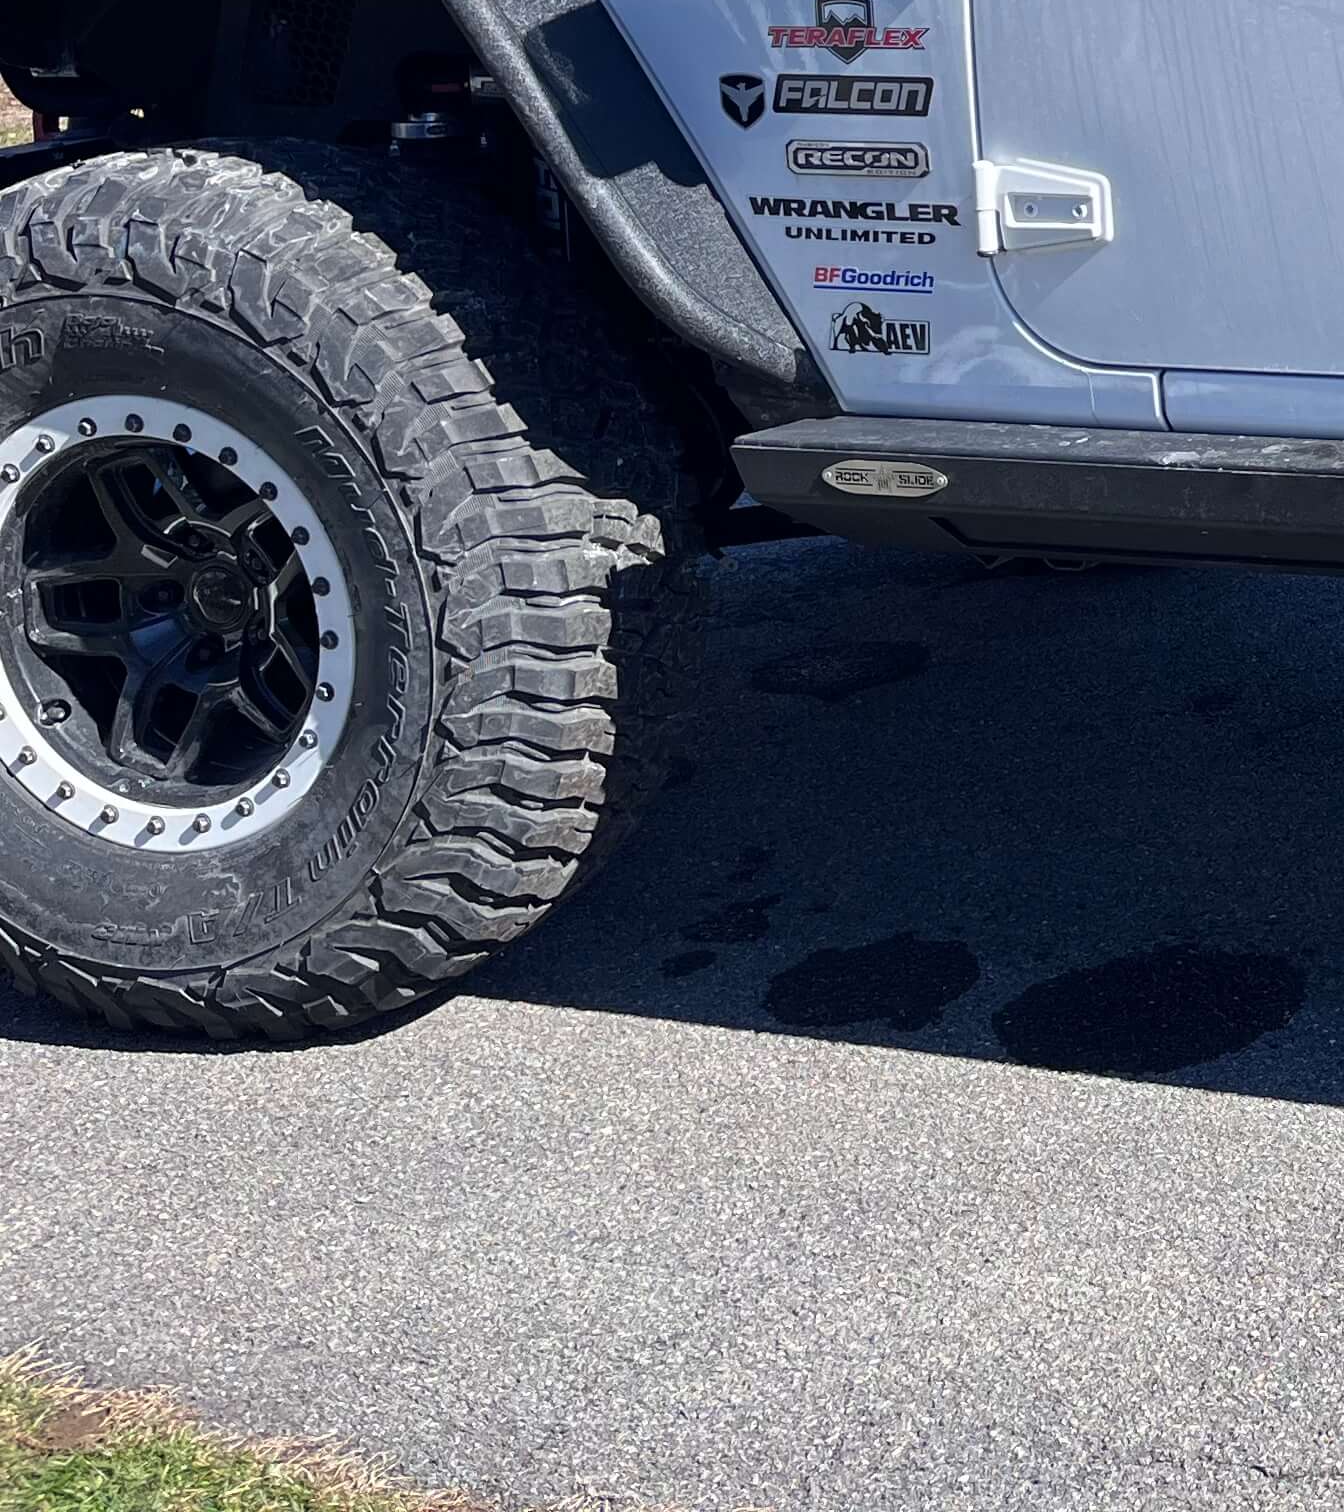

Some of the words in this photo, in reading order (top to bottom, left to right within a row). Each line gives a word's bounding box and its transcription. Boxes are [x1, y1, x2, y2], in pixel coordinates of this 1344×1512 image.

[768, 26, 930, 49] TERAFLEX
[778, 79, 928, 111] FALCON
[797, 150, 916, 167] RECON
[749, 196, 961, 226] WRANGLER
[785, 226, 936, 245] UNLIMITED
[814, 267, 934, 287] BFGoodrich
[885, 322, 928, 351] AEV
[834, 471, 869, 483] ROCK
[899, 474, 934, 486] SLIDE
